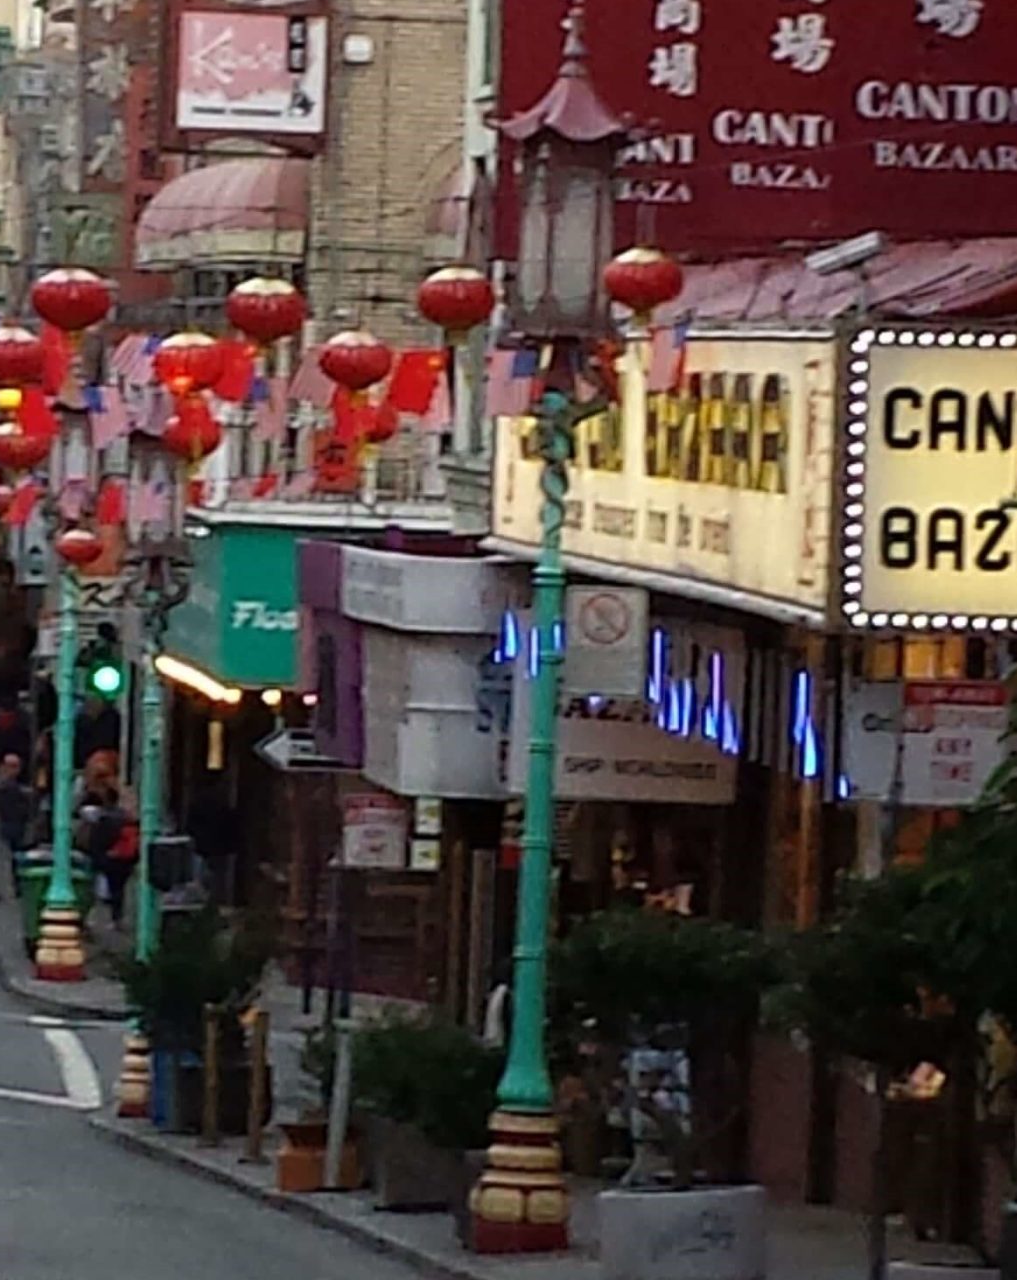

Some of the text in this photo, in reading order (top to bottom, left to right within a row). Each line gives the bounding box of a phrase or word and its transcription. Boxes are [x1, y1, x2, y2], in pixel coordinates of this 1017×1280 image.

[713, 109, 834, 147] CANT
[615, 135, 695, 167] ANT
[875, 140, 1017, 172] BAZAAR
[884, 387, 1015, 452] CAN
[880, 506, 1011, 572] BAZ
